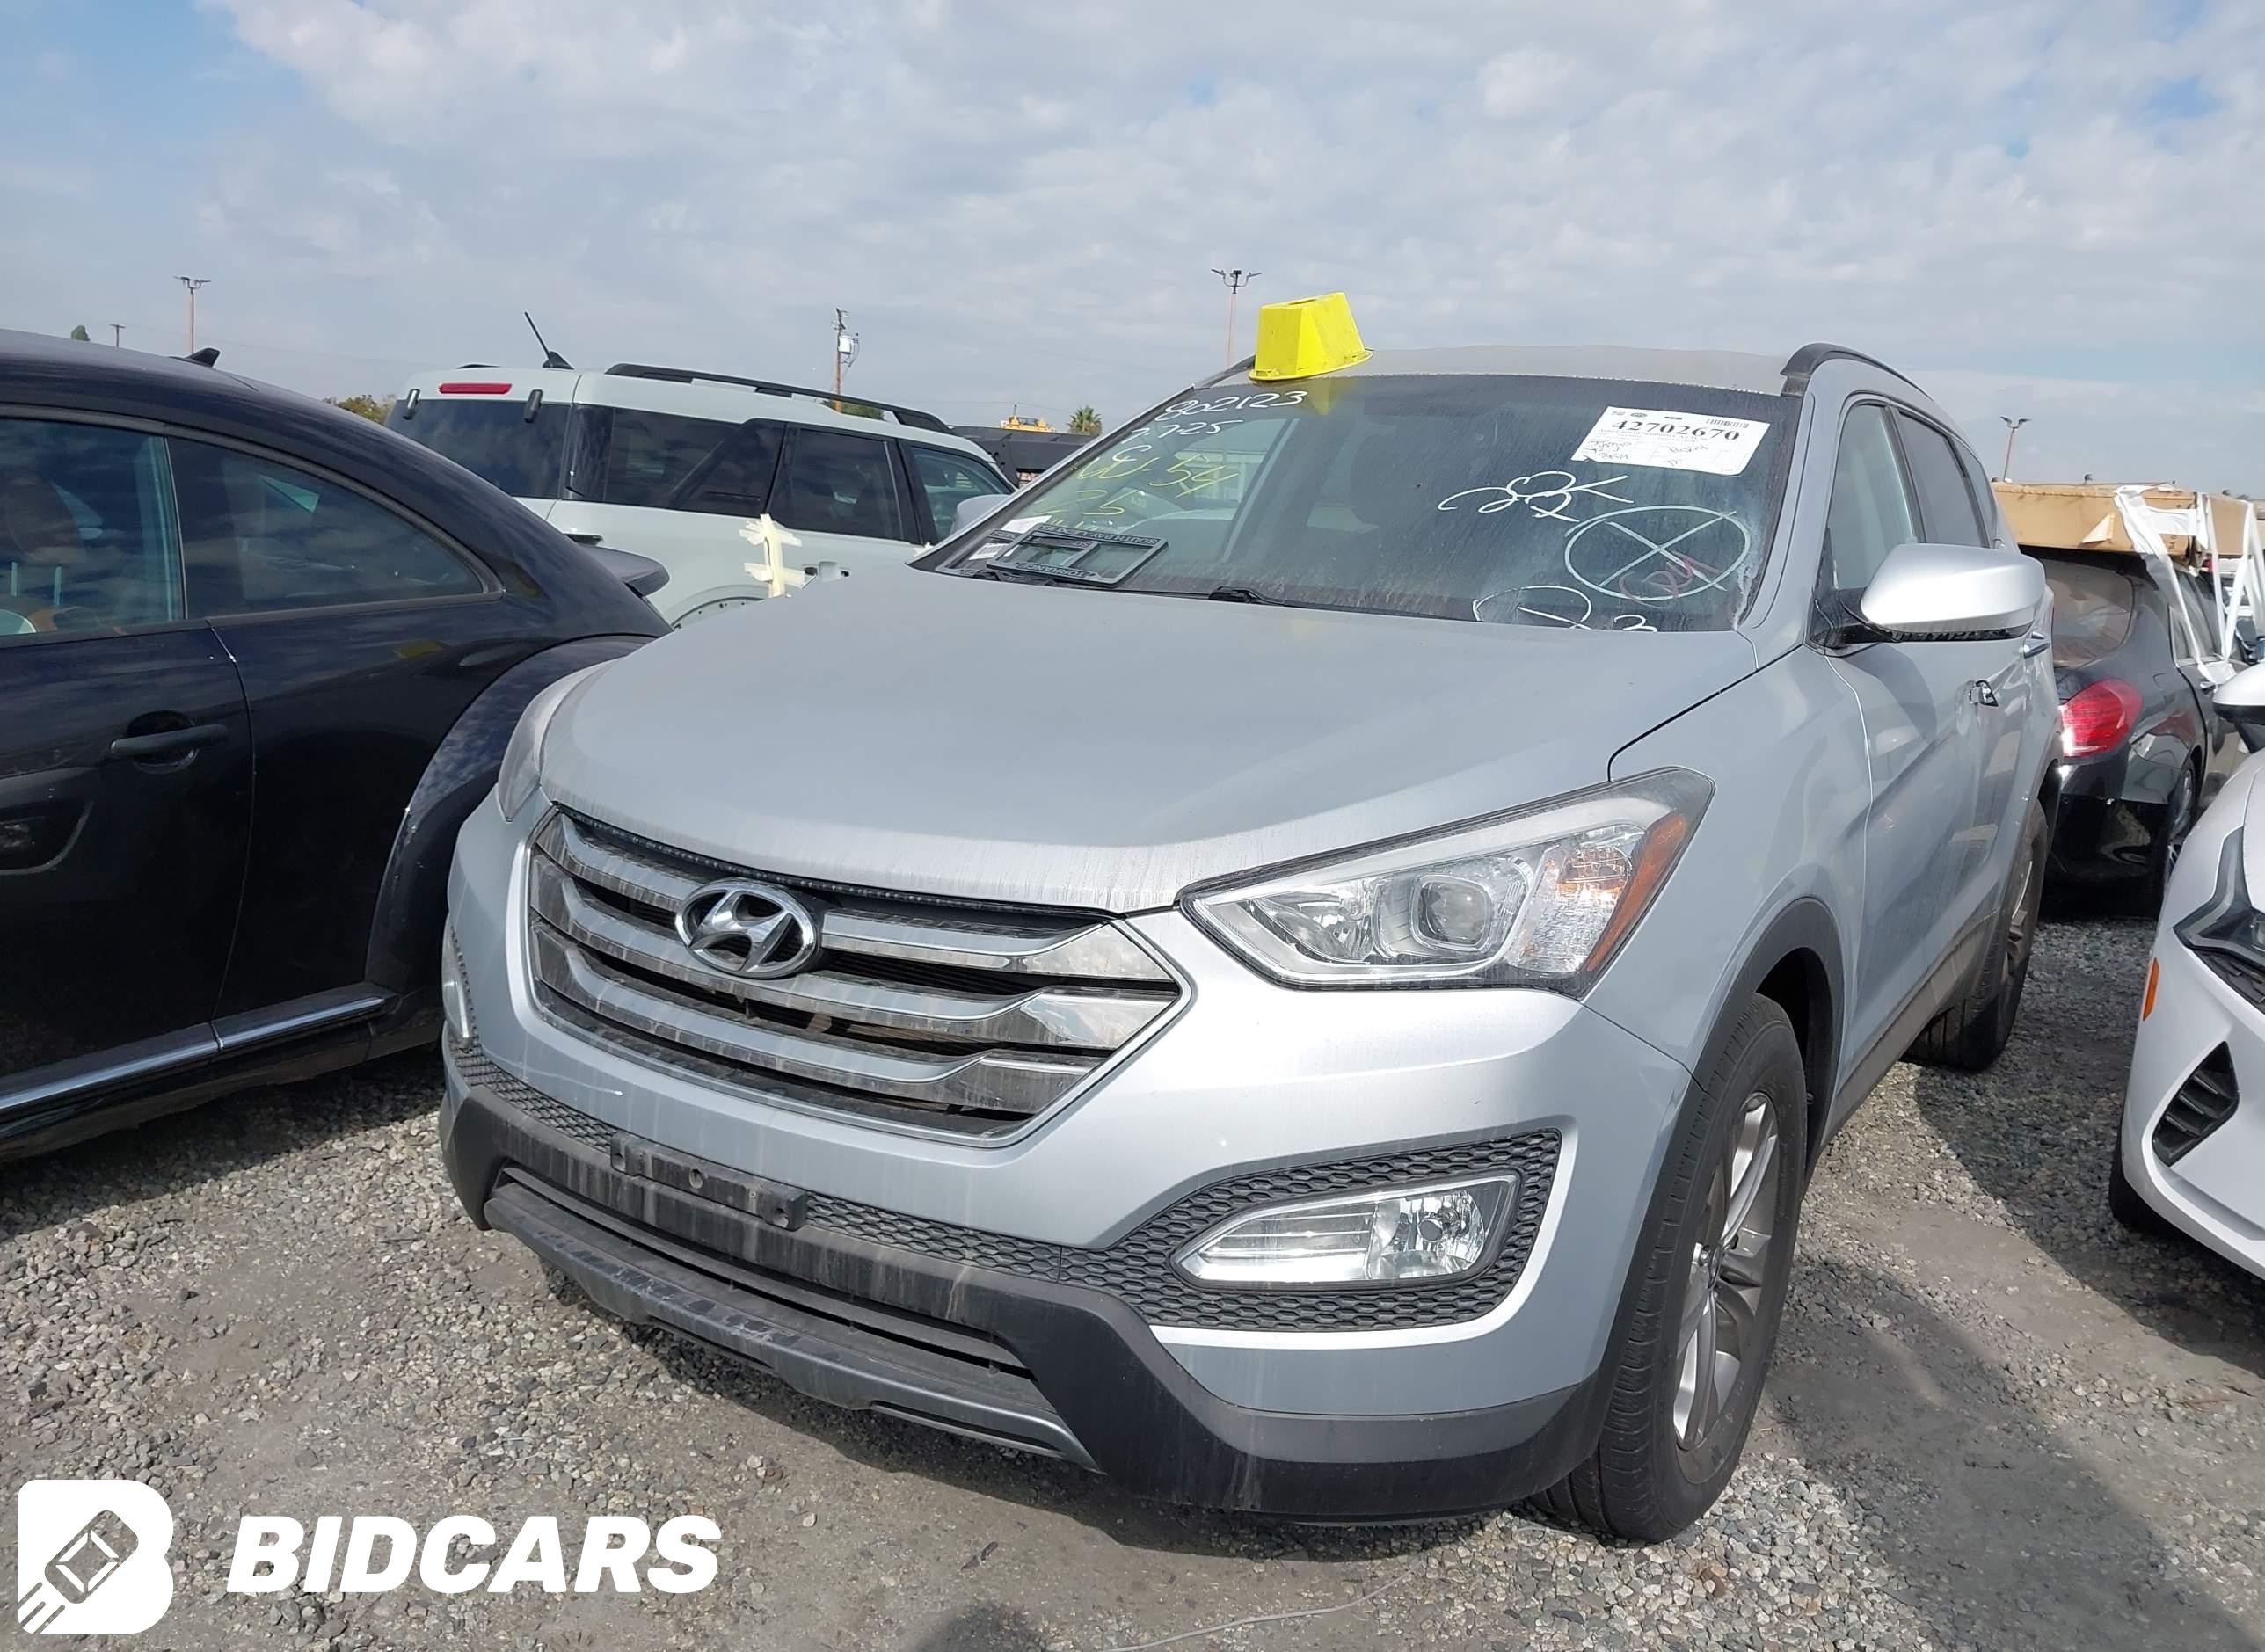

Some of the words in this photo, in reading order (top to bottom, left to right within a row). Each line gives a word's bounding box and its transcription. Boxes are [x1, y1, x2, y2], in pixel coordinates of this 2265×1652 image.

[1611, 420, 1740, 440] 42702670
[1091, 531, 1114, 540] BAY
[1114, 534, 1158, 545] SOUTH
[1017, 563, 1084, 577] TORRANCE
